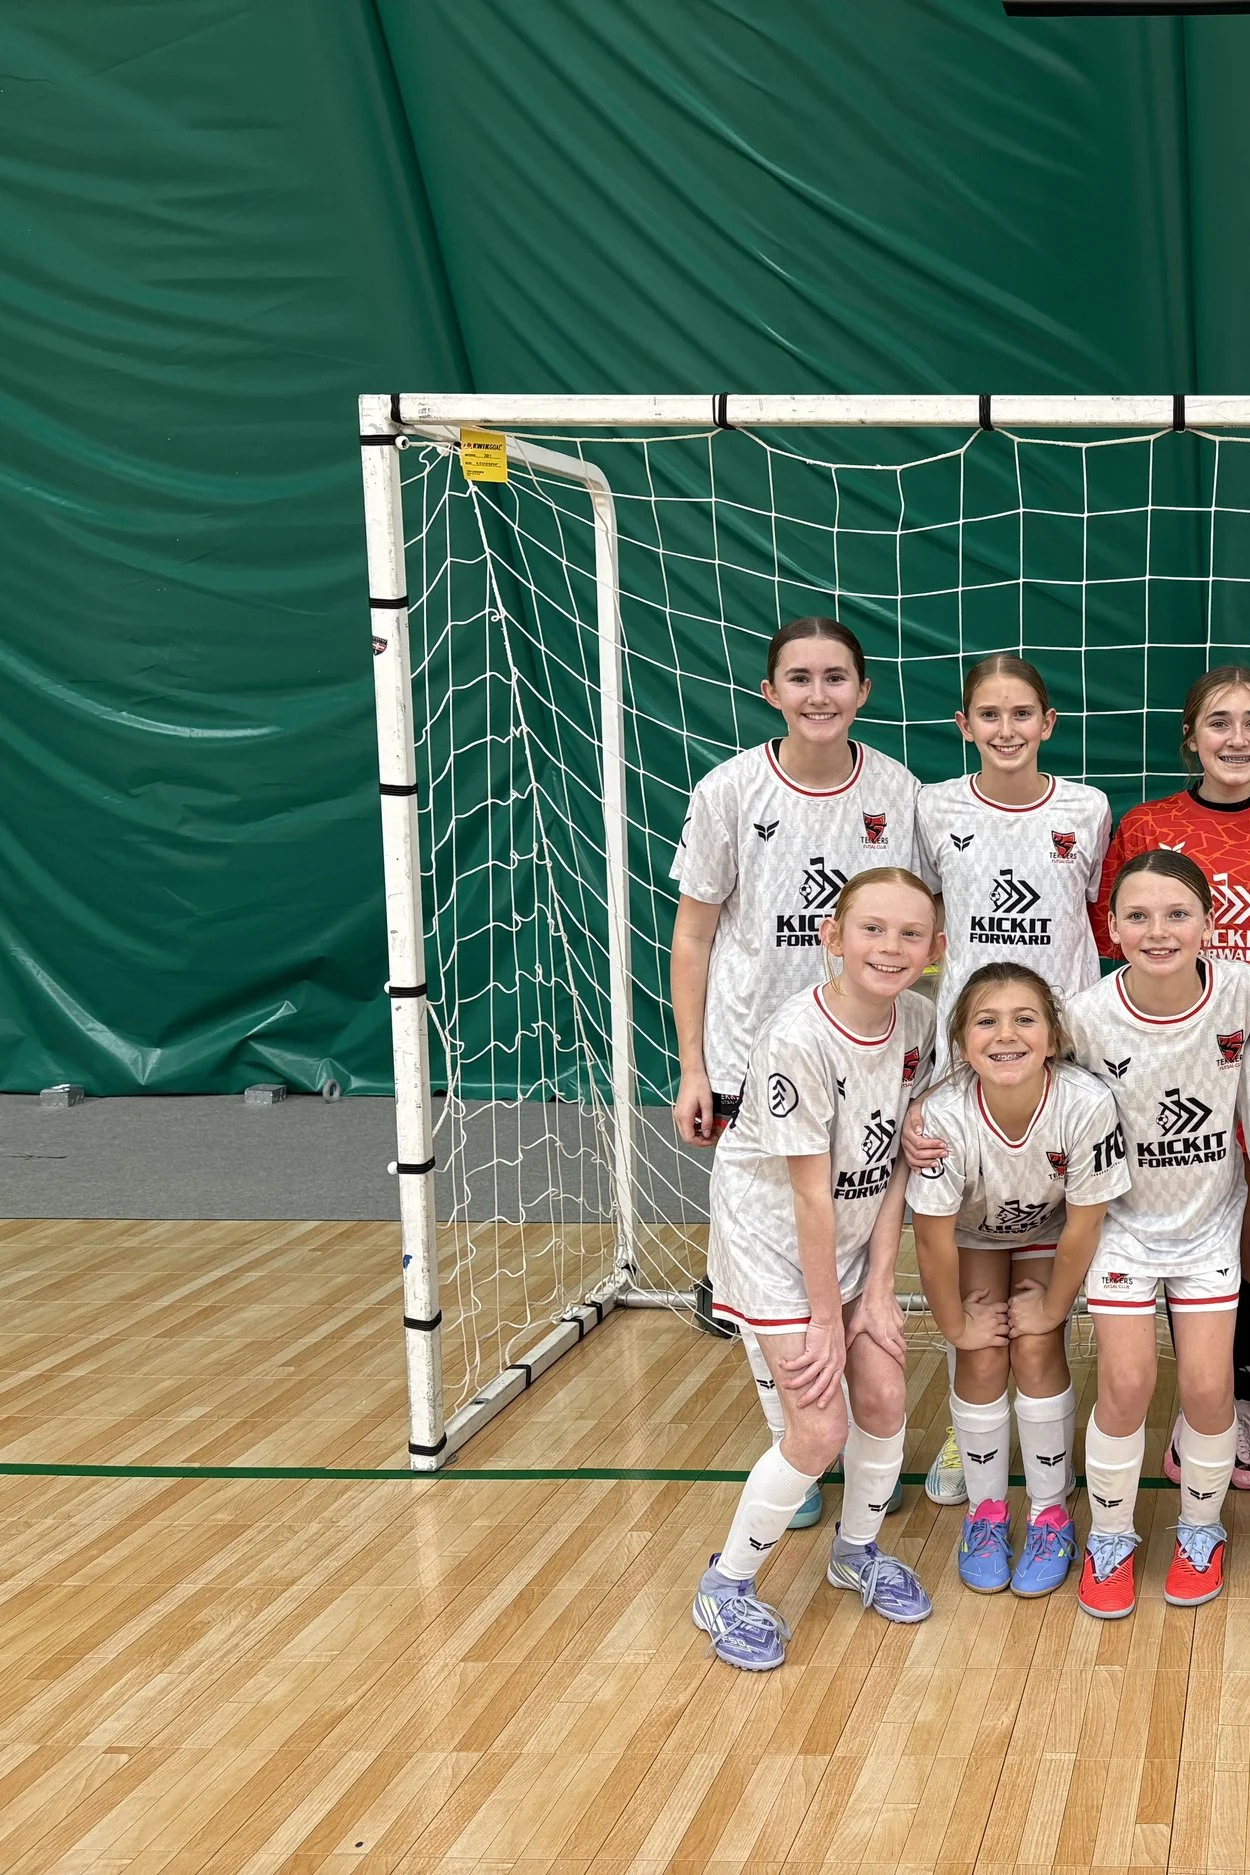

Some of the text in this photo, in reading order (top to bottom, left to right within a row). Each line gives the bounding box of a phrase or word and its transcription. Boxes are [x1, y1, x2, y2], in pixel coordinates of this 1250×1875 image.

[776, 914, 832, 933] KIC
[970, 916, 1052, 934] KICKIT
[969, 932, 1051, 945] FORWARD
[1136, 1130, 1228, 1157] KICKIT
[1137, 1147, 1227, 1168] FORWARD
[837, 1162, 893, 1188] KICK
[833, 1180, 889, 1200] FORWA
